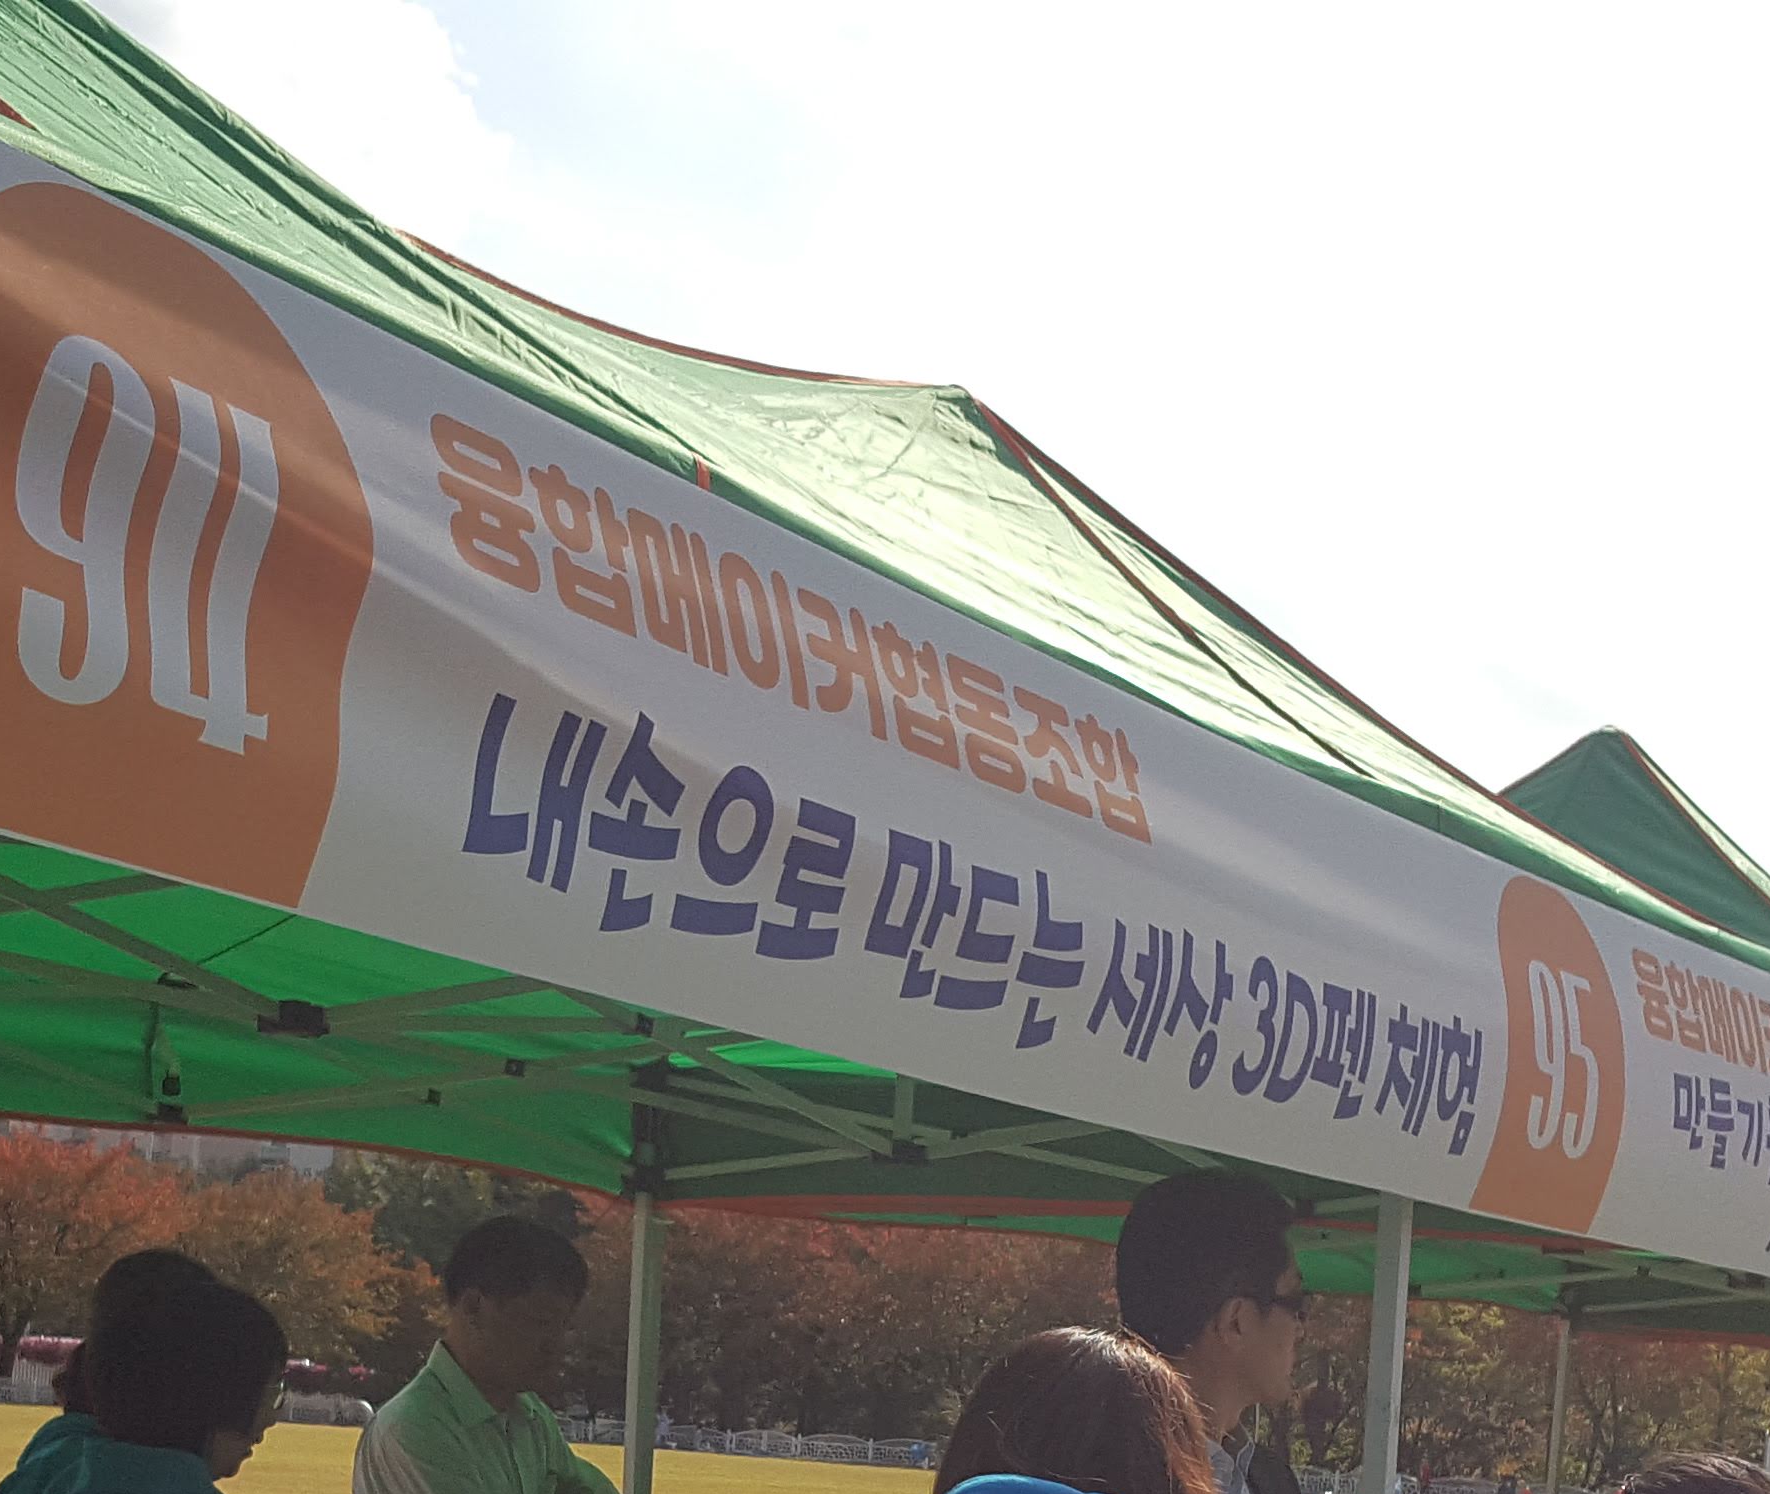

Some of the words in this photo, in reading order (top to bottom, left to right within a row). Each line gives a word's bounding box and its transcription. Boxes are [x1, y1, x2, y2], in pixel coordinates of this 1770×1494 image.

[14, 334, 280, 755] 94
[433, 414, 1152, 844] 융합메이커협동조합
[865, 832, 1085, 1050] 만드는
[1086, 918, 1233, 1090] 세상
[1374, 1001, 1485, 1156] 체험
[1529, 960, 1599, 1159] 95
